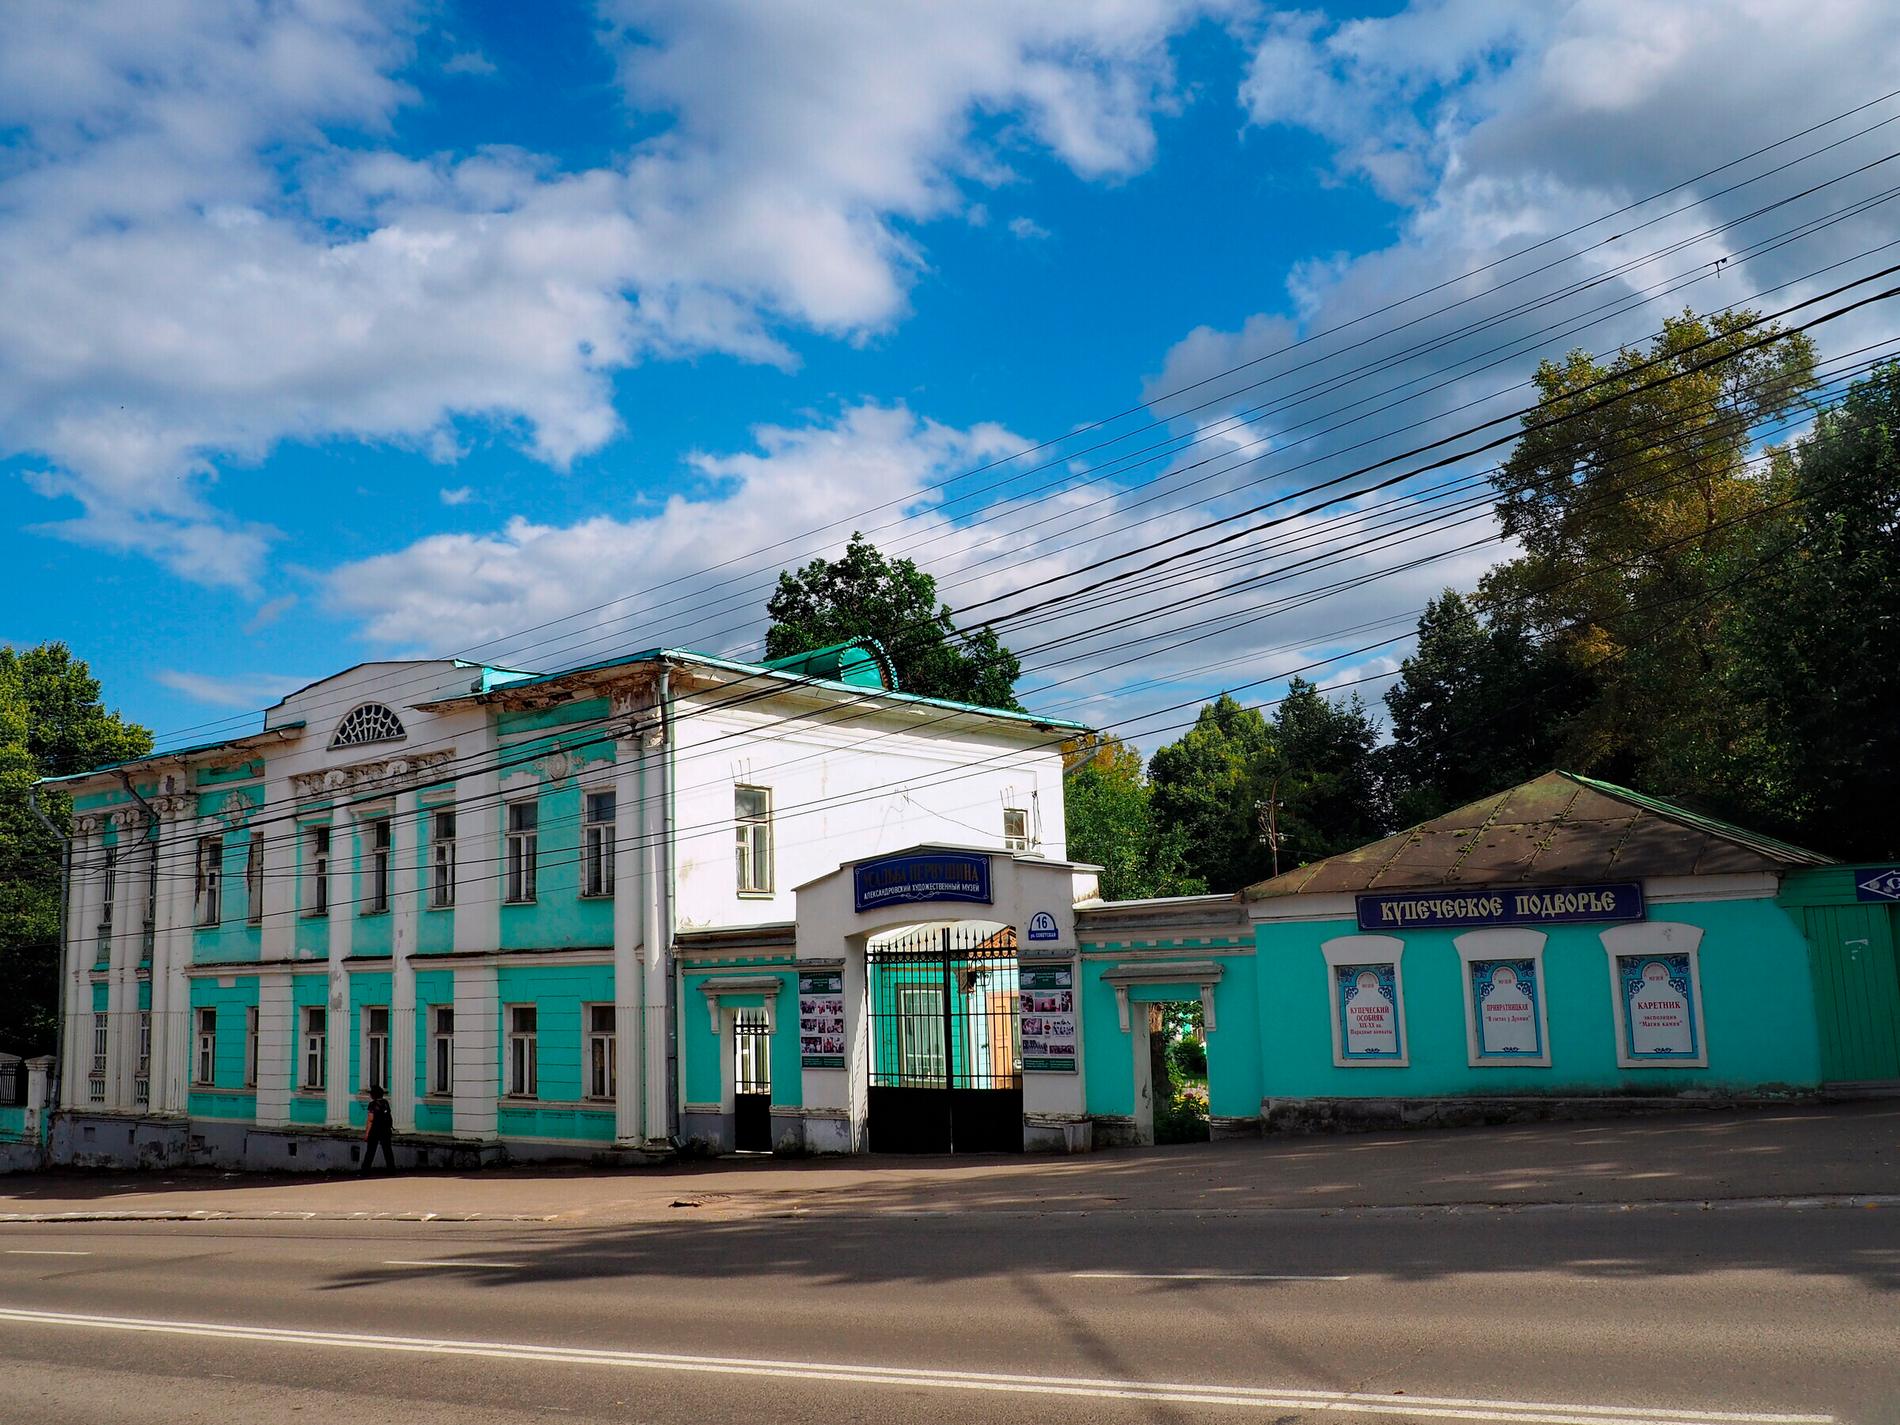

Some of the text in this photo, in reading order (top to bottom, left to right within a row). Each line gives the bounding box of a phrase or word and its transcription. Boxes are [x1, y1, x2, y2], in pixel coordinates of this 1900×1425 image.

[864, 881, 980, 900] АЛЕКСАНДРОВСКИЙ ХУДОЖЕСТВЕННЫЙ МУЗЕЙ
[1380, 892, 1616, 925] КУПЕЧЕСКОЕ ПОДВОРЬЕ
[1036, 916, 1048, 929] 16
[1350, 1006, 1390, 1014] КУПЕЧЕСКИЙ
[1356, 1014, 1384, 1022] ОСОБНЯК
